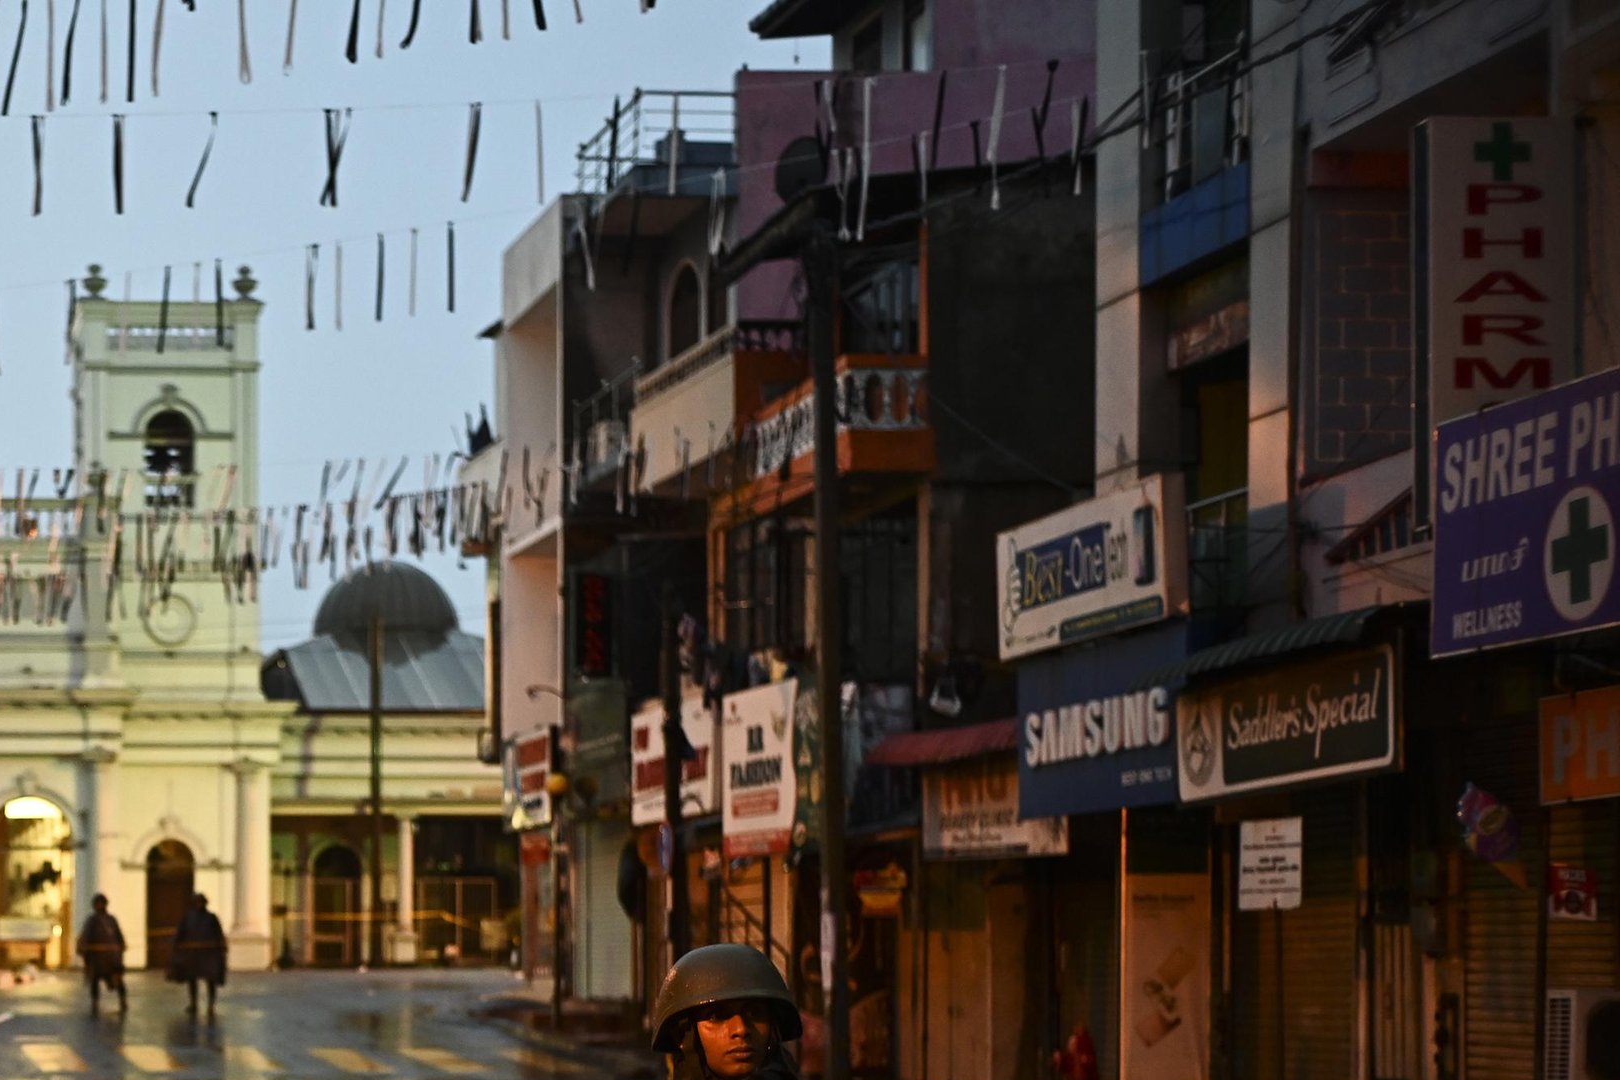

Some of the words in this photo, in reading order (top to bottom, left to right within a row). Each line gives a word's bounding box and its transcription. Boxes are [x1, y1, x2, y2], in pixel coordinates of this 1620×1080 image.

[1441, 411, 1559, 514] SHREE
[1452, 600, 1523, 640] WELLNESS
[1025, 687, 1167, 768] SAMSUNG
[1227, 691, 1302, 750] Saddler's
[1303, 668, 1381, 759] Special
